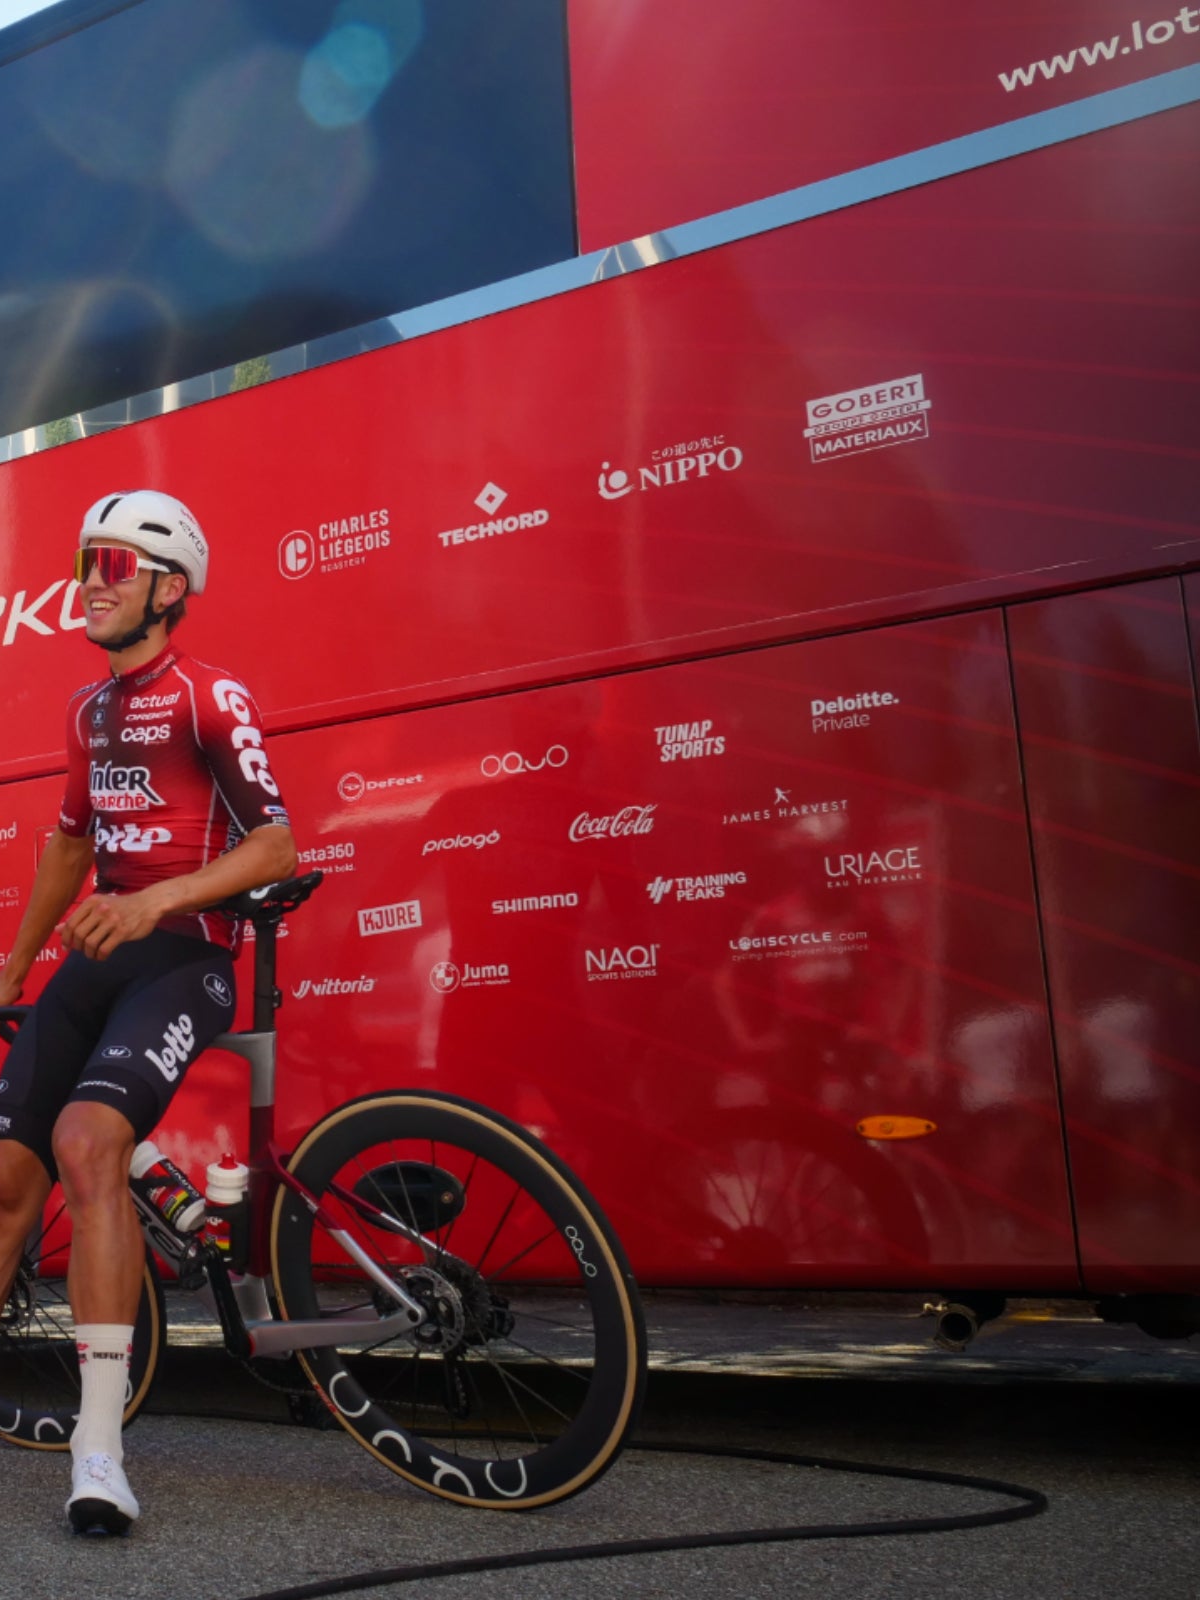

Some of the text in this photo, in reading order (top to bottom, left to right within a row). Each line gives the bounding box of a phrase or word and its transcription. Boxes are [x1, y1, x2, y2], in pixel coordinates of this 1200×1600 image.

[998, 6, 1200, 92] www.lot
[812, 381, 919, 418] GOBERT
[814, 418, 923, 455] MATERIAUX
[638, 446, 743, 491] NIPPO
[318, 508, 390, 541] CHARLES
[437, 509, 549, 547] TECHNORD
[319, 529, 391, 561] LIÉGEOIS
[129, 690, 181, 709] actual
[810, 691, 899, 716] Deloitte.
[120, 723, 171, 746] caps
[654, 719, 713, 746] TUNAP
[811, 712, 871, 734] Private
[660, 736, 725, 763] SPORTS
[722, 799, 849, 825] JAMES HARVEST
[296, 842, 355, 864] nsta360
[824, 846, 921, 878] URIAGE
[676, 871, 748, 890] TRAINING
[676, 886, 726, 902] PEAKS
[492, 893, 579, 915] SHIMANO
[362, 904, 417, 932] KJURE
[585, 944, 657, 973] NAQI
[311, 976, 375, 996] vittoria
[461, 963, 510, 982] Juma
[145, 1013, 196, 1083] lotto
